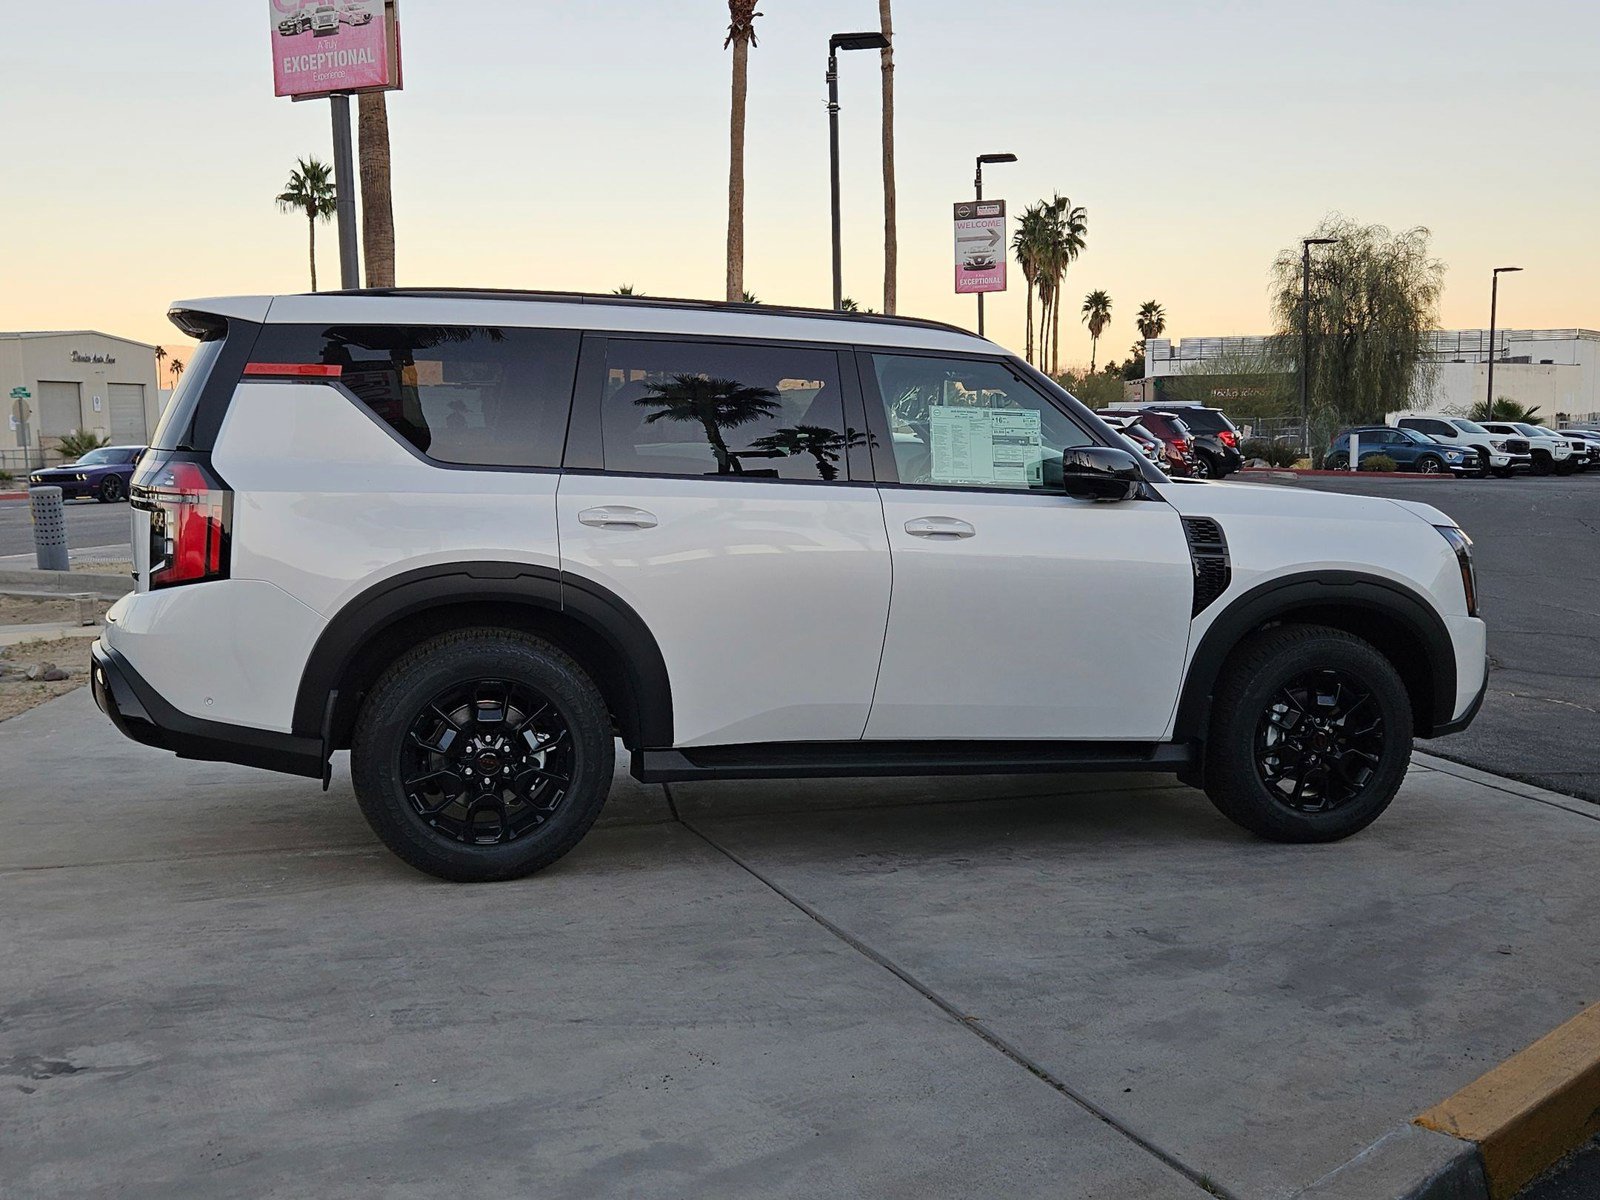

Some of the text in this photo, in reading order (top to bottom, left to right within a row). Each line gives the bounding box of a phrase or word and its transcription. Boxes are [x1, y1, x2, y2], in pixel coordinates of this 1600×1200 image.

[283, 48, 375, 74] EXCEPTIONAL
[313, 70, 346, 82] Experience
[957, 219, 1001, 229] WELCOME
[960, 277, 1002, 286] EXCEPTIONAL
